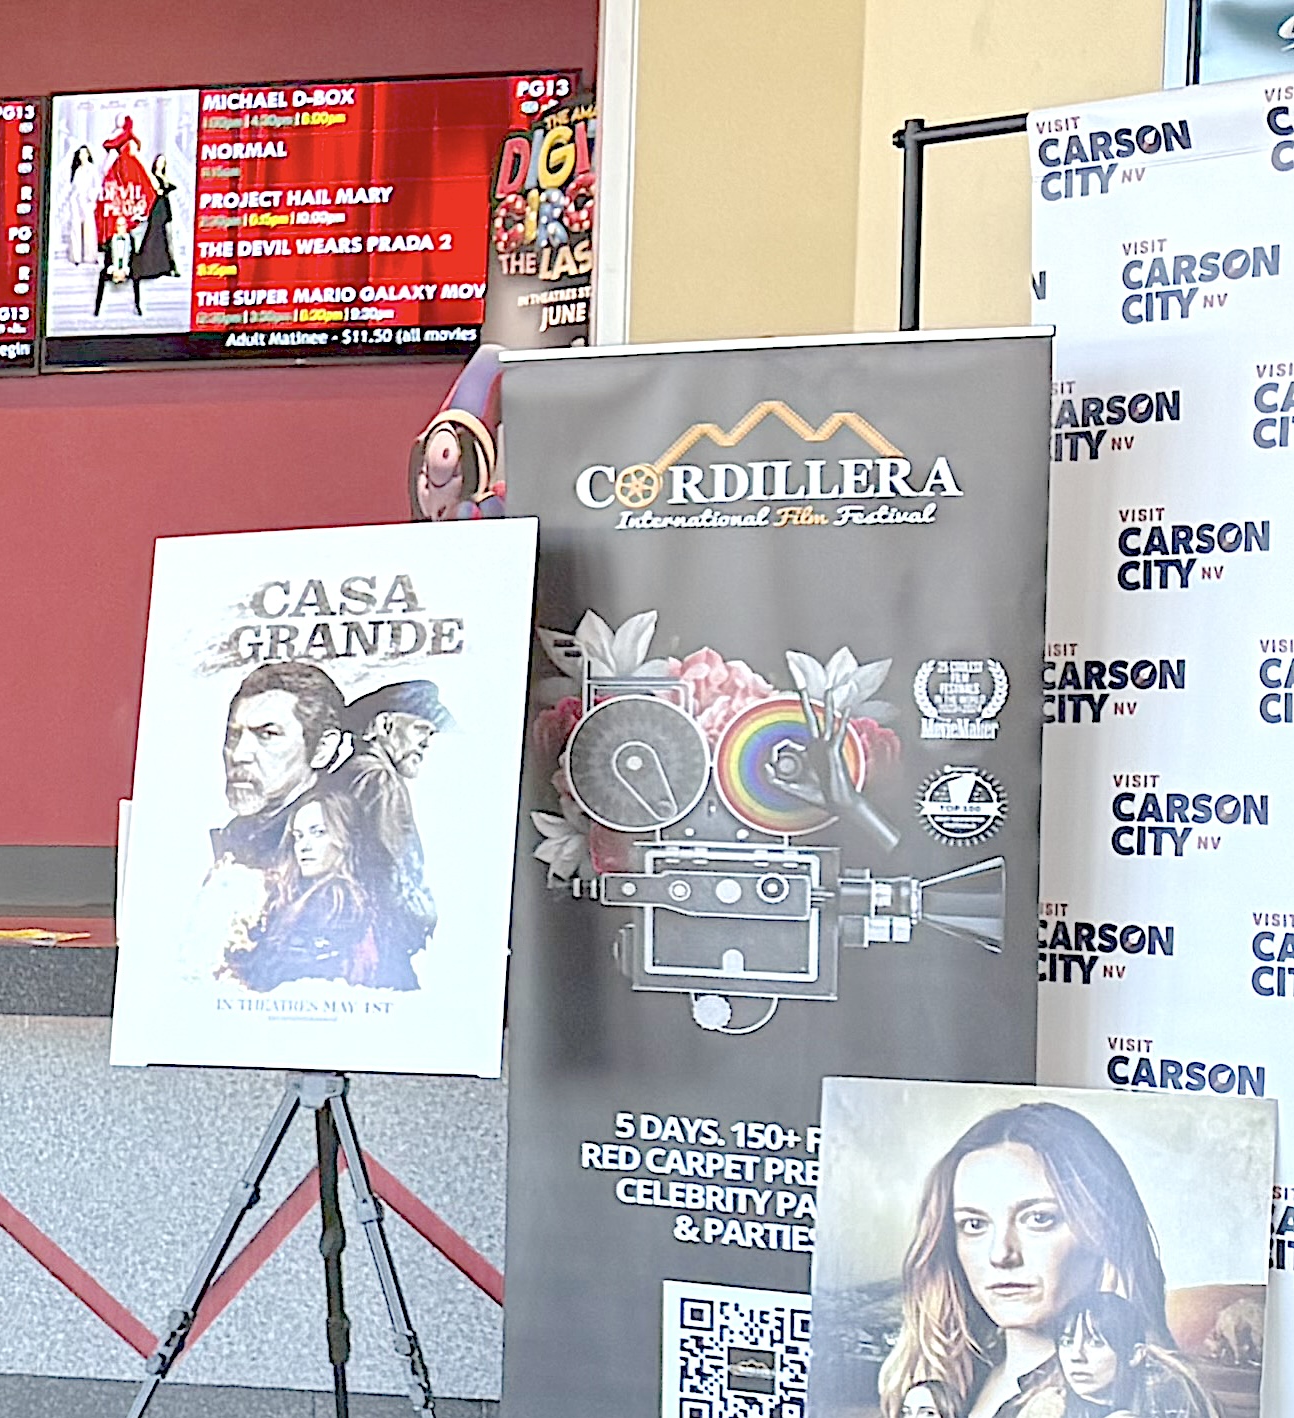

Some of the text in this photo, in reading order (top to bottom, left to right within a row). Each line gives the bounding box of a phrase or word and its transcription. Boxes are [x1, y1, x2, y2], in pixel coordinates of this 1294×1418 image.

[202, 86, 355, 111] MICHAEL D-BOX
[516, 79, 570, 98] PG13
[1036, 116, 1080, 134] VISIT
[22, 145, 34, 160] R
[201, 141, 288, 160] NORMAL
[1038, 120, 1192, 168] CARSON
[20, 186, 32, 201] R
[1040, 163, 1146, 201] CITY NV
[199, 186, 394, 209] PROJECT HAIL MARY
[197, 234, 452, 259] THE DEVIL WEARS PRADA 2
[1122, 238, 1167, 256] VISIT
[18, 266, 30, 281] R
[498, 252, 537, 275] THE
[1122, 244, 1280, 290] CARSON
[196, 283, 486, 306] THE SUPER MARIO GALAXY MOV
[1121, 287, 1228, 325] CITY NV
[539, 302, 586, 332] JUNE
[225, 332, 266, 347] Adult
[268, 331, 328, 346] Matinee
[341, 329, 393, 344] $11.50
[423, 327, 477, 342] movies
[1051, 429, 1135, 462] ITY NV
[1253, 416, 1294, 449] CI
[576, 456, 964, 509] CORDILLERA
[615, 503, 937, 532] International Film Festival
[1119, 507, 1165, 523] VISIT
[1118, 520, 1270, 556] CARSON
[1117, 558, 1224, 591] CITY NV
[249, 574, 425, 619] CASA
[229, 618, 464, 662] GRANDE
[1113, 701, 1138, 716] NV
[1113, 774, 1160, 788] VISIT
[1112, 792, 1269, 825] CARSON
[1112, 826, 1221, 856] CITY NV
[1103, 965, 1294, 997] NV CI
[216, 998, 394, 1014] IN THEATRES MAY 1ST
[1108, 1037, 1153, 1053] VISIT
[1107, 1055, 1266, 1097] CARSON
[615, 1111, 802, 1150] 5 DAYS. 150+
[581, 1142, 641, 1171] RED
[645, 1147, 761, 1182] CARPET
[616, 1177, 817, 1220] CELEBRITY PA
[673, 1214, 700, 1243] &
